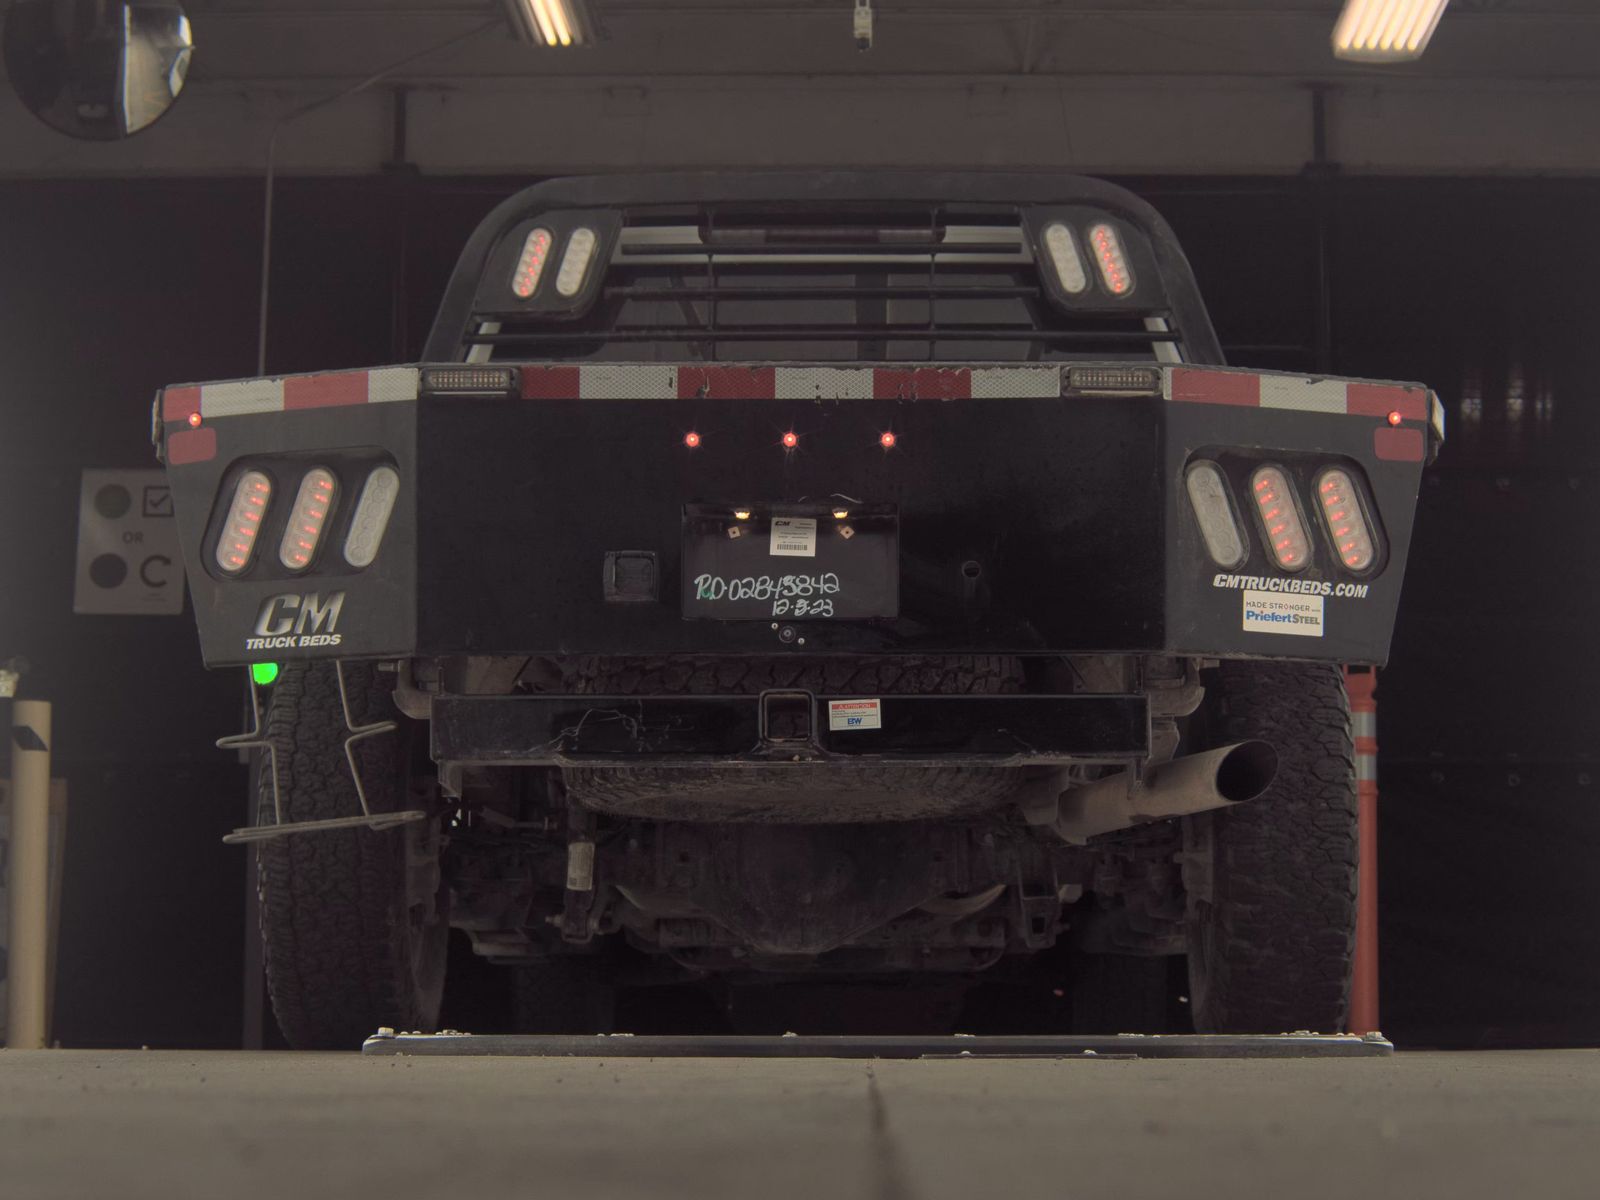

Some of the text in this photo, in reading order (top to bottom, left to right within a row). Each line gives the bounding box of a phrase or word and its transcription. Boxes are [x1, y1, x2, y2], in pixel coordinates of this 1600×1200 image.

[122, 531, 144, 544] OR
[1213, 574, 1368, 598] CMTRUCKBEDS.COM
[255, 592, 345, 636] CM
[1246, 601, 1268, 609] MADE
[1269, 603, 1311, 612] STRONGER
[246, 634, 342, 649] TRUCK BEDS
